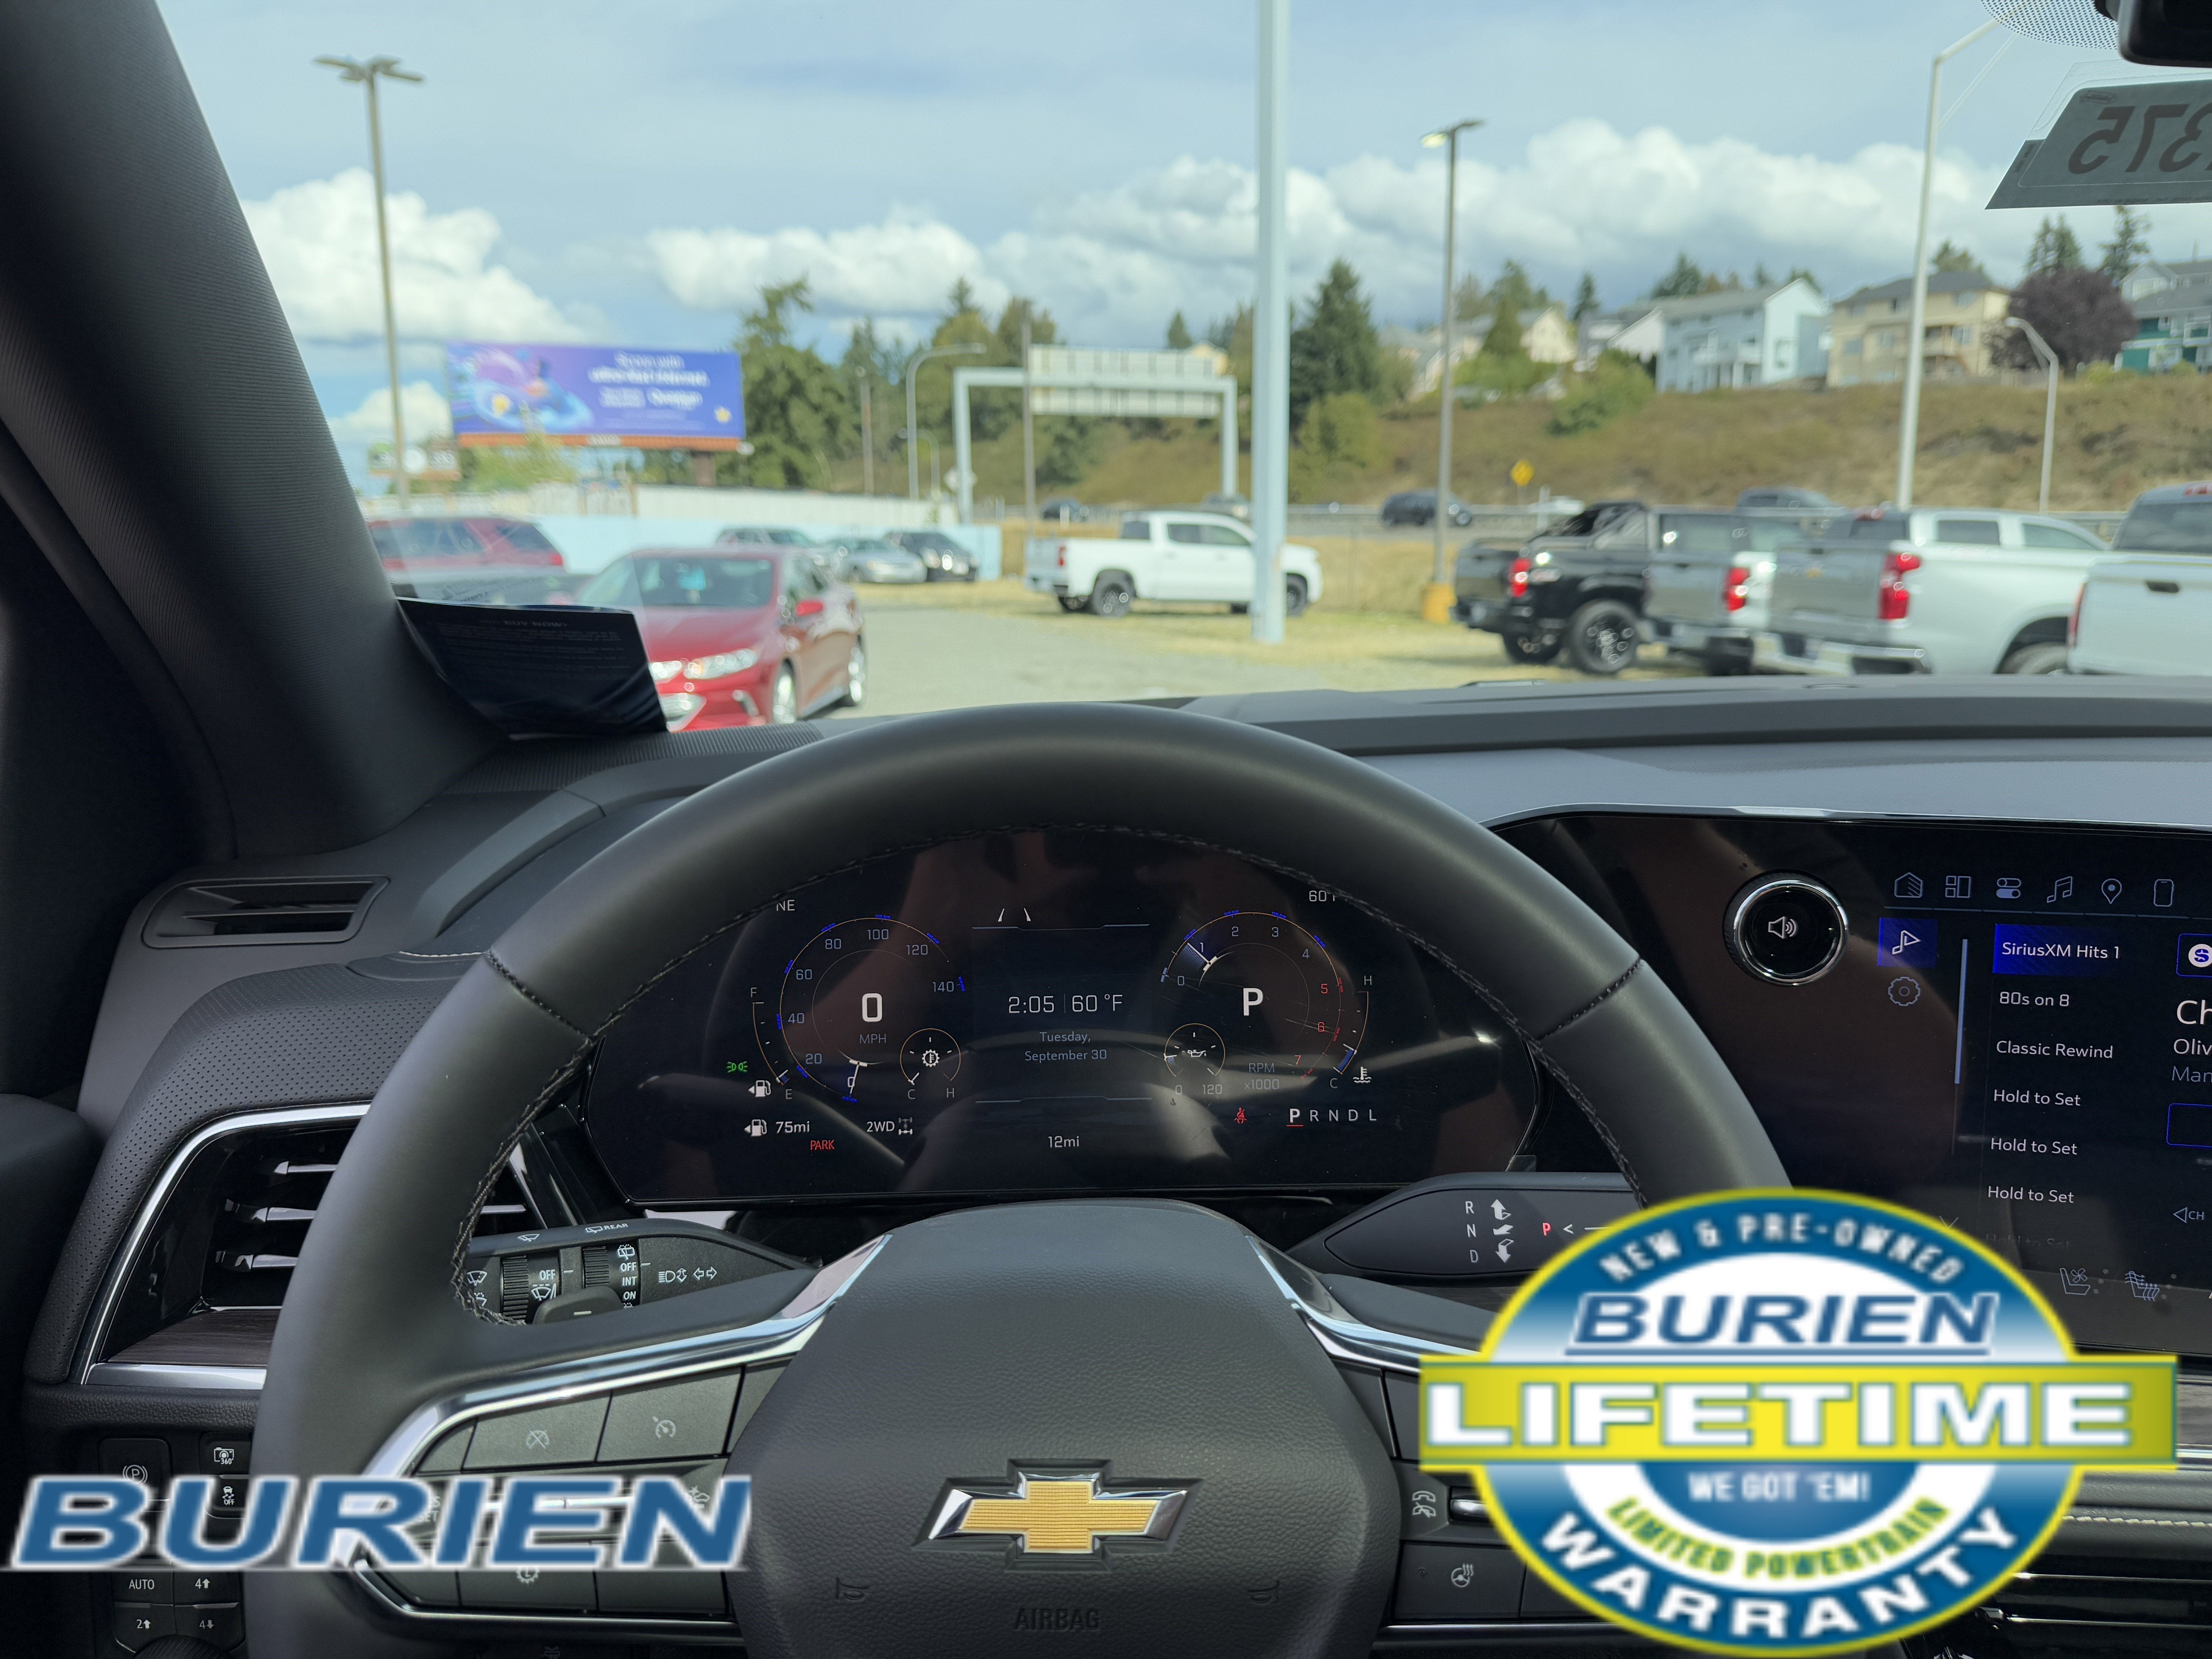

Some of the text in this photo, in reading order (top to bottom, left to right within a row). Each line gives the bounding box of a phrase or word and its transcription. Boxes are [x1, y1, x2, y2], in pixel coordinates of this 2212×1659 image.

[776, 900, 795, 911] NE
[867, 929, 889, 940] 100
[1231, 926, 1239, 937] 2
[1271, 927, 1279, 937] 3
[825, 938, 842, 950] 80
[906, 944, 928, 955] 120
[1199, 942, 1204, 953] 1
[1302, 948, 1310, 958] 4
[2001, 941, 2119, 959] SiriusXM Hits 1
[796, 969, 812, 980] 60
[1364, 975, 1372, 985] H
[1177, 975, 1185, 986] 0
[933, 981, 954, 992] 140
[1321, 983, 1328, 994] 5
[750, 987, 757, 998] F
[1009, 996, 1054, 1013] 2:05
[1072, 995, 1097, 1012] 60
[1243, 988, 1263, 1016] P
[1999, 991, 2069, 1006] 80s on 8
[862, 993, 883, 1022] 0
[788, 1013, 805, 1024] 40
[1317, 1022, 1326, 1032] 6
[859, 1034, 886, 1044] MPH
[1039, 1030, 1091, 1044] Tuesday,
[1996, 1040, 2113, 1058] Classic Rewind
[805, 1053, 822, 1064] 20
[1025, 1049, 1107, 1064] September 30
[1295, 1055, 1301, 1065] 7
[1248, 1063, 1276, 1074] RPM
[1244, 1079, 1279, 1090] x1000
[1330, 1078, 1338, 1089] C
[785, 1089, 792, 1099] E
[907, 1087, 955, 1099] C H
[1175, 1084, 1223, 1095] 0 120
[1994, 1089, 2080, 1106] Hold to Set
[1290, 1108, 1377, 1123] P R N D L
[776, 1121, 810, 1133] 75mi
[867, 1121, 895, 1132] 2WD
[810, 1140, 835, 1150] PARK
[1048, 1135, 1079, 1148] 12mi
[1991, 1137, 2077, 1155] Hold to Set
[1988, 1186, 2074, 1203] Hold to Set
[1465, 1201, 1474, 1214] R
[2188, 1211, 2204, 1220] CH
[1467, 1224, 1476, 1237] N
[1542, 1223, 1551, 1236] P
[1469, 1249, 1479, 1263] D
[620, 1261, 637, 1272] OFF
[539, 1269, 556, 1281] OFF
[622, 1276, 637, 1286] INT
[623, 1291, 636, 1300] ON
[129, 1579, 155, 1590] AUTO
[195, 1578, 202, 1589] 4
[136, 1619, 143, 1629] 2
[199, 1620, 206, 1629] 4
[1013, 1608, 1100, 1632] AIRBAG
